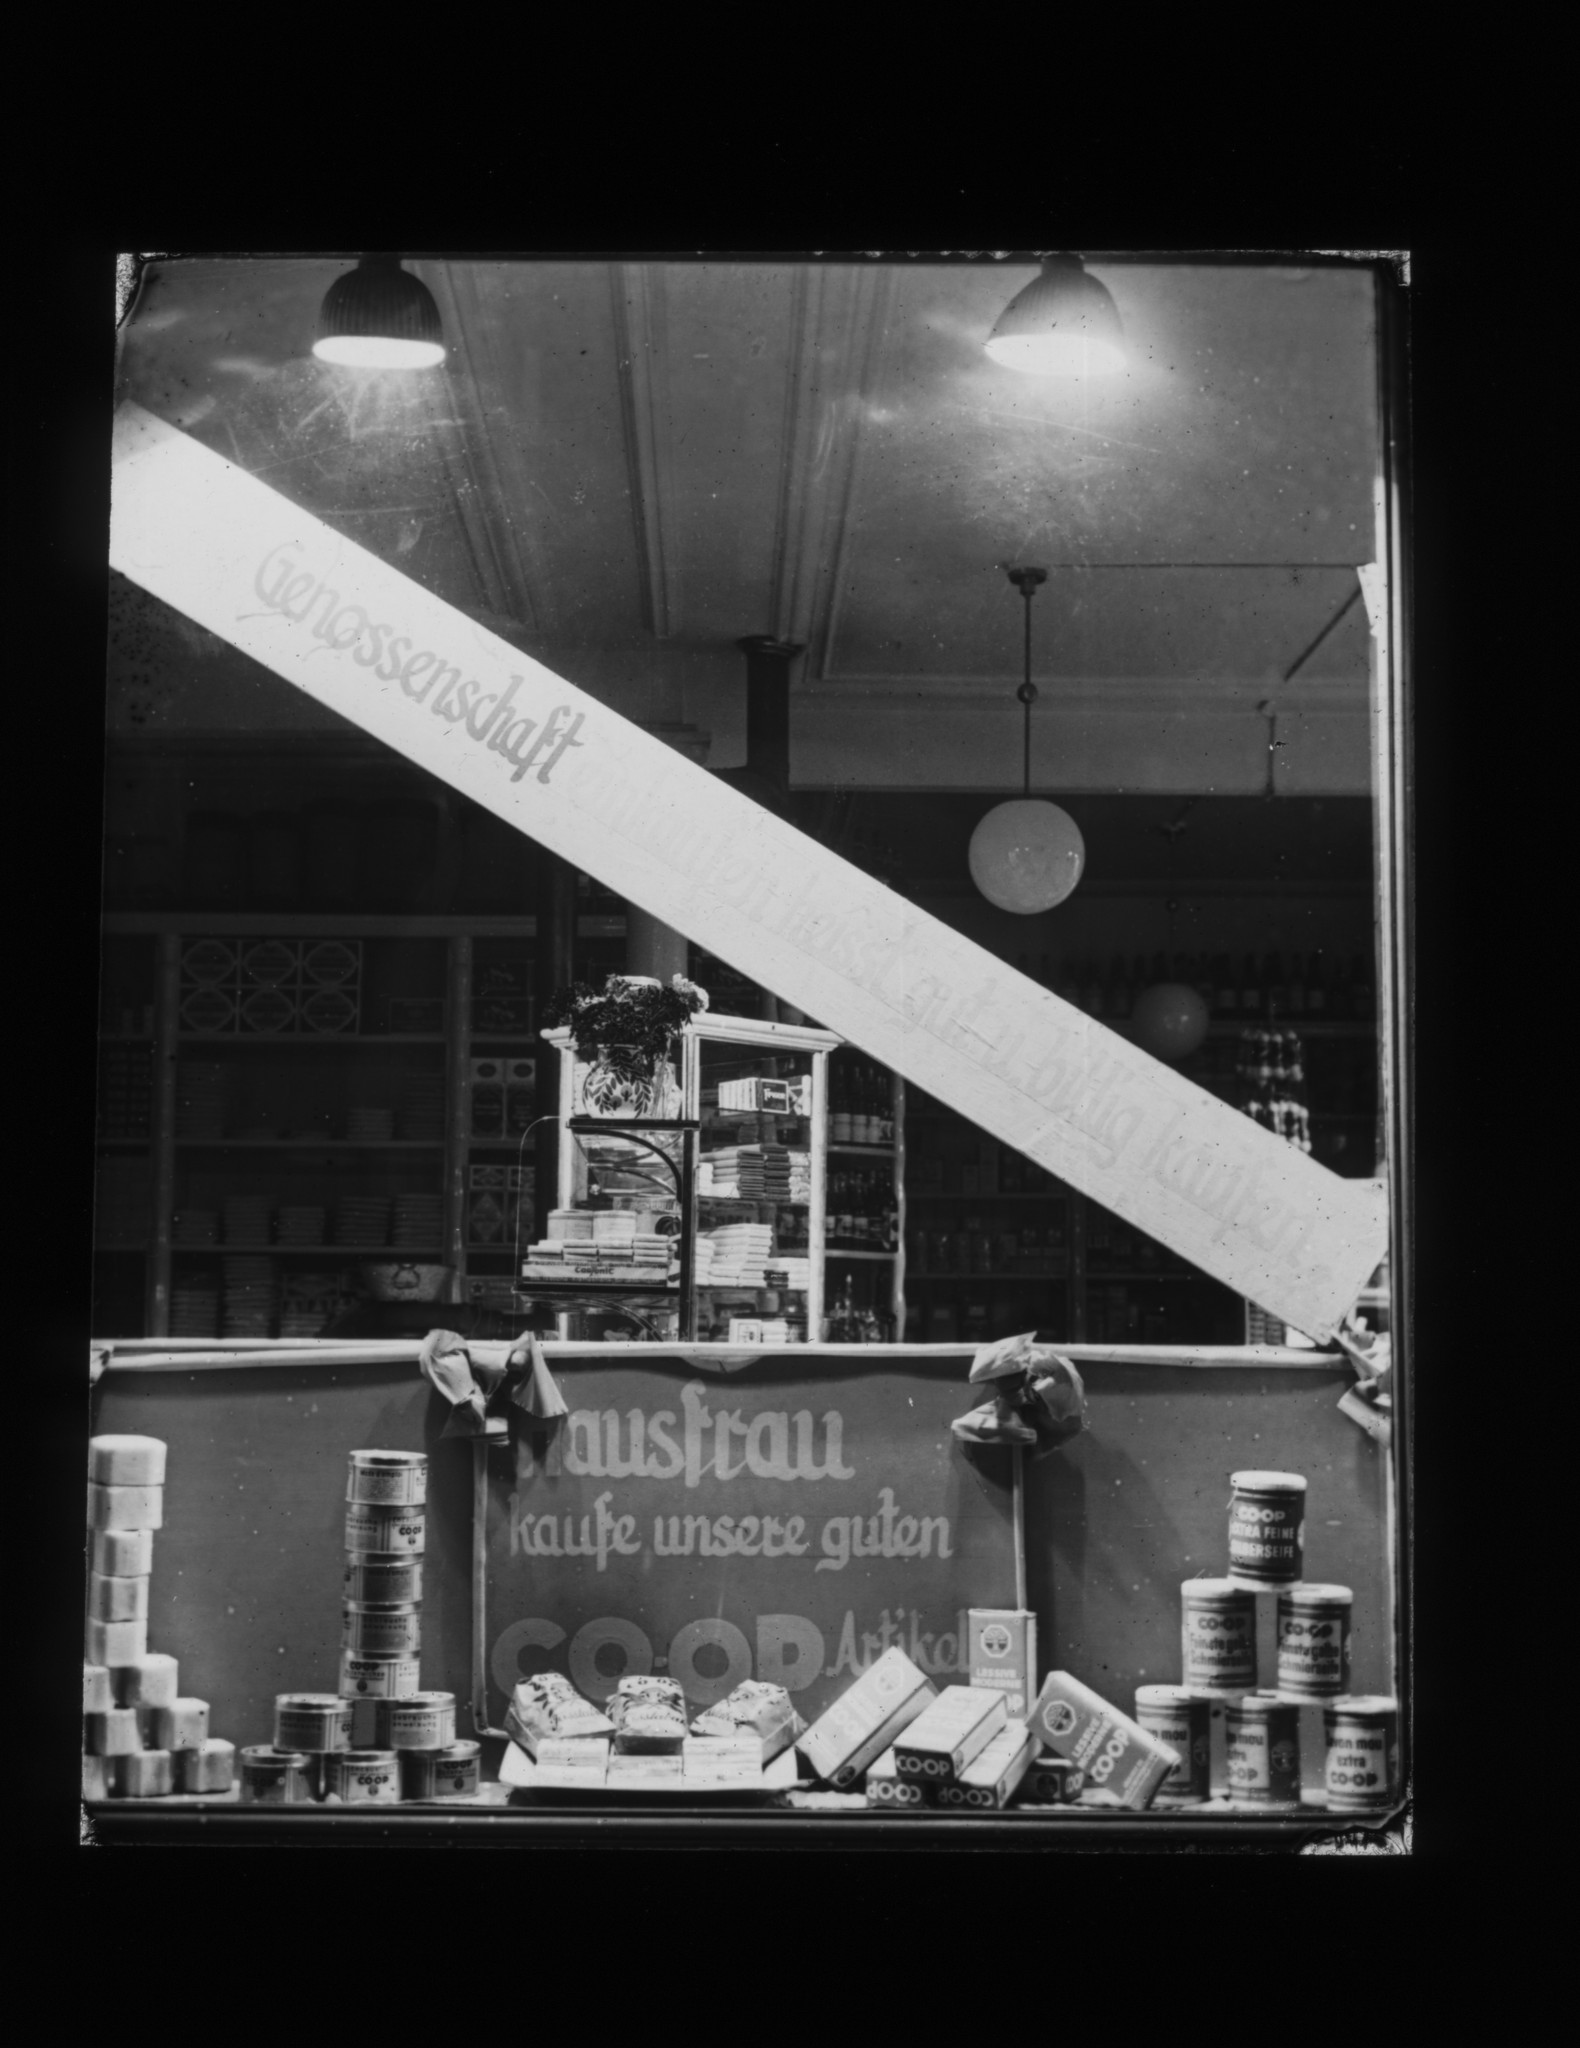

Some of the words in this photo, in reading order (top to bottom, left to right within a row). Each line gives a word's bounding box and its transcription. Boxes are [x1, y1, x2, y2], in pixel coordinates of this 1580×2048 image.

[236, 541, 585, 784] Genossenschaft
[510, 1491, 642, 1572] kaufe
[653, 1514, 809, 1558] unsere
[814, 1487, 953, 1573] guten
[1264, 1527, 1294, 1539] FEINE
[1356, 1739, 1382, 1751] mou
